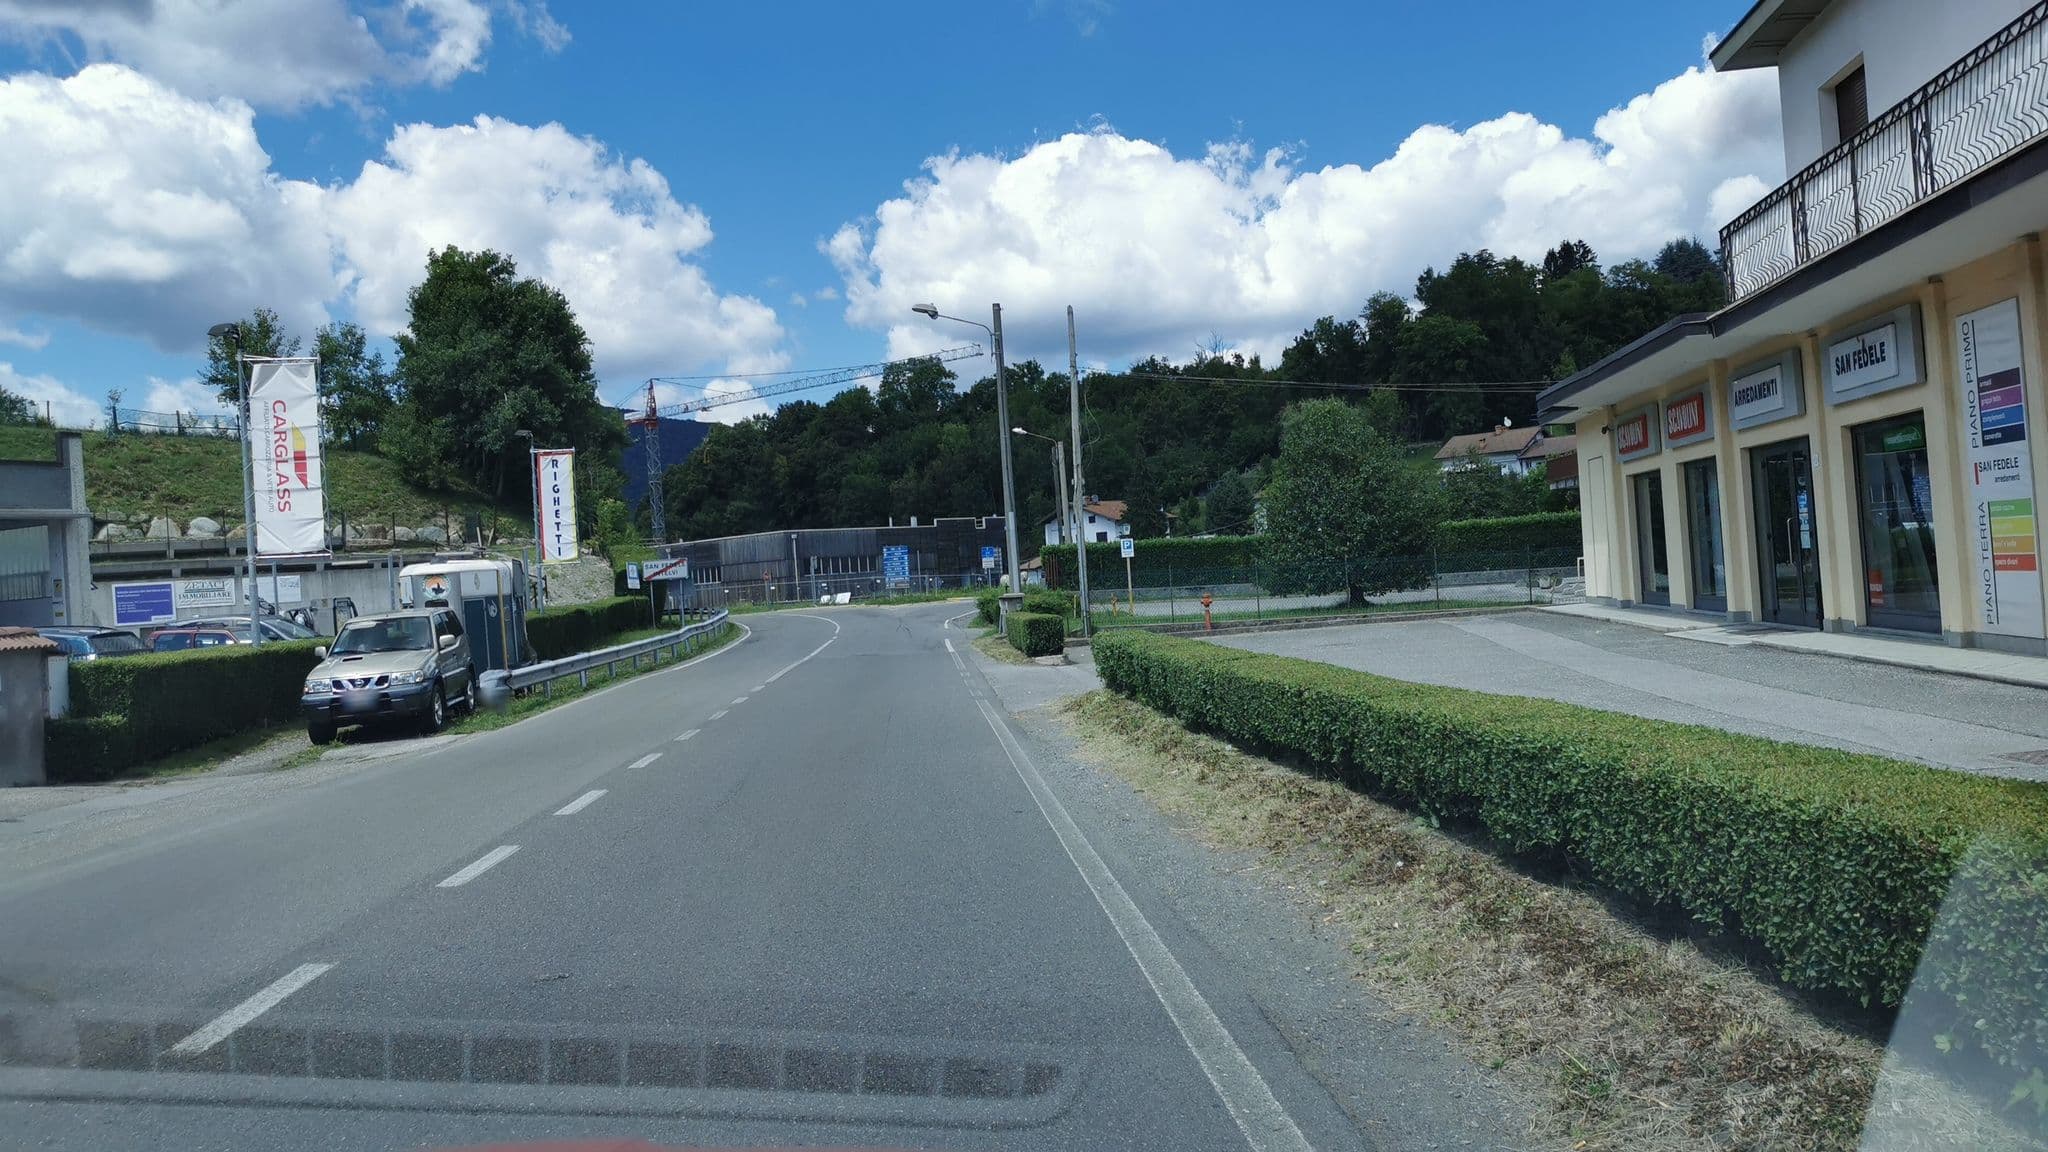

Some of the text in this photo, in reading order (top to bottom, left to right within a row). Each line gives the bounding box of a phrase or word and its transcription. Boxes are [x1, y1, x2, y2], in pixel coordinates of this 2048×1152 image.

[1834, 340, 1887, 377] SAN FEDELE
[1734, 378, 1778, 408] ARREDAMENTI
[1961, 321, 1980, 449] PIANO PRIMO
[272, 399, 292, 513] CARGLASS
[1979, 456, 2019, 473] SAN FEDELE
[551, 459, 562, 557] RIGHETTI
[644, 562, 659, 570] SAN
[1977, 501, 1995, 625] PIANO TERRA
[178, 591, 232, 600] IMMOBILIARE
